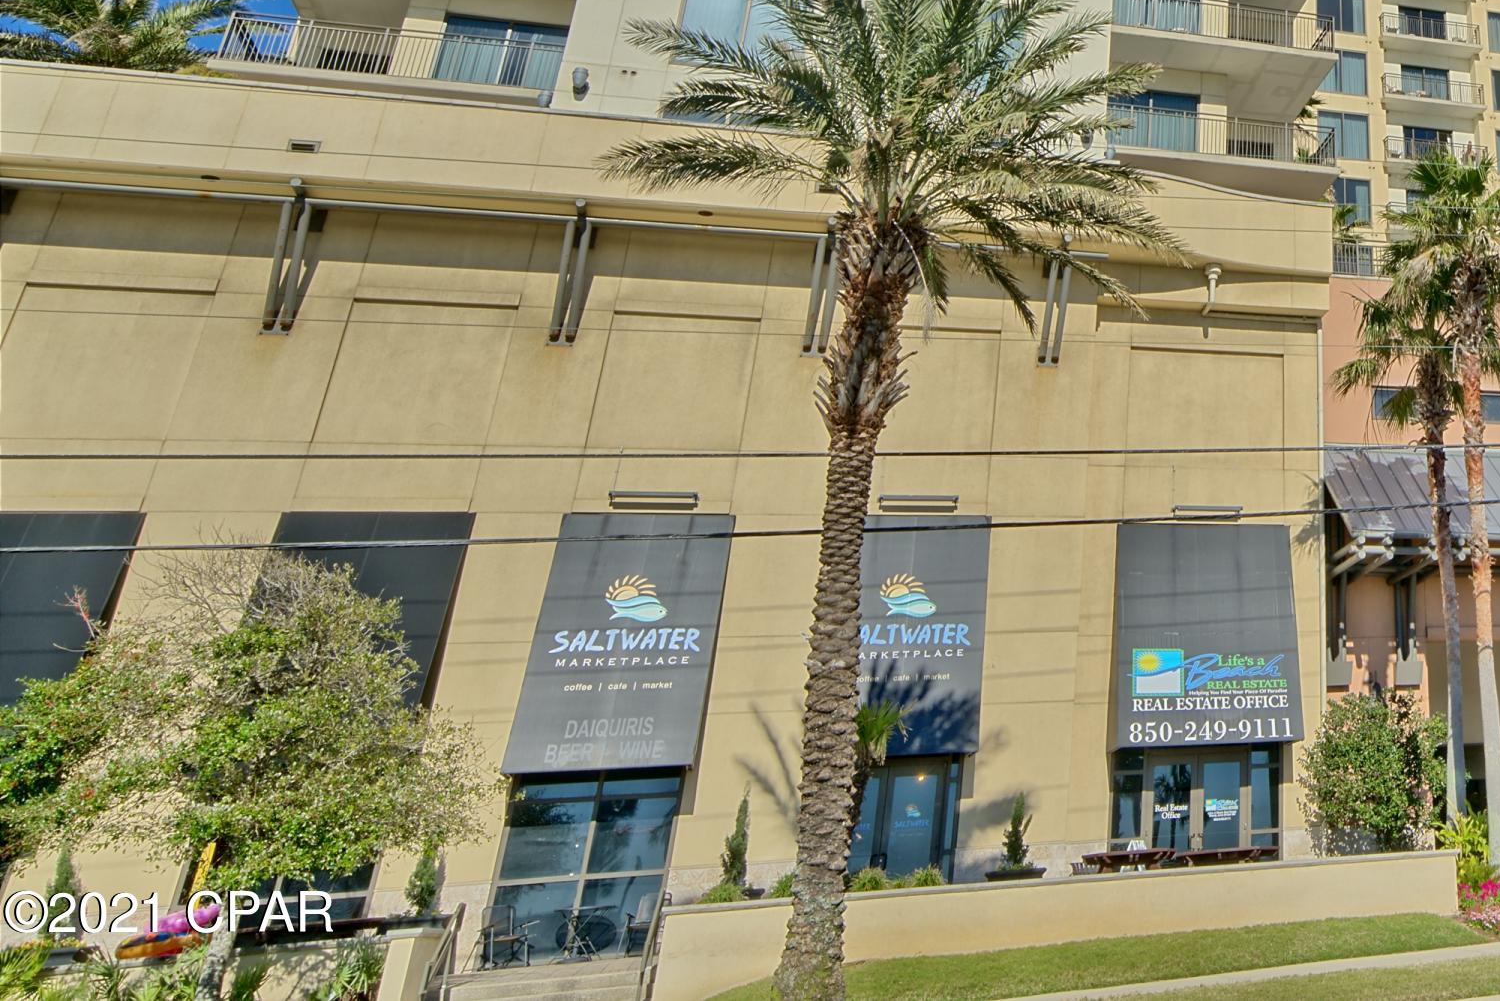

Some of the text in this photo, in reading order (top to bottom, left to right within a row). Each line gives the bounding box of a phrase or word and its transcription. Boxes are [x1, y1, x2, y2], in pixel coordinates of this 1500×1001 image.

[548, 627, 700, 654] SALTWATER
[859, 623, 971, 646] ALTWATER
[555, 655, 690, 667] MARKETPLACE
[858, 649, 964, 659] ARKETPLACE
[1218, 654, 1266, 666] Life's a
[1185, 653, 1285, 690] Beach
[563, 683, 593, 692] coffee
[608, 682, 628, 690] cafe
[642, 681, 673, 689] market
[1207, 679, 1288, 689] REAL ESTATE
[1132, 695, 1289, 712] REAL ESTATE OFFICE
[564, 716, 654, 739] DAIQUIRIS
[1129, 717, 1293, 743] 850-249-9111
[543, 743, 594, 764] BEER
[619, 740, 665, 759] WINE
[1154, 803, 1188, 812] Real Estate
[1161, 811, 1181, 819] Office
